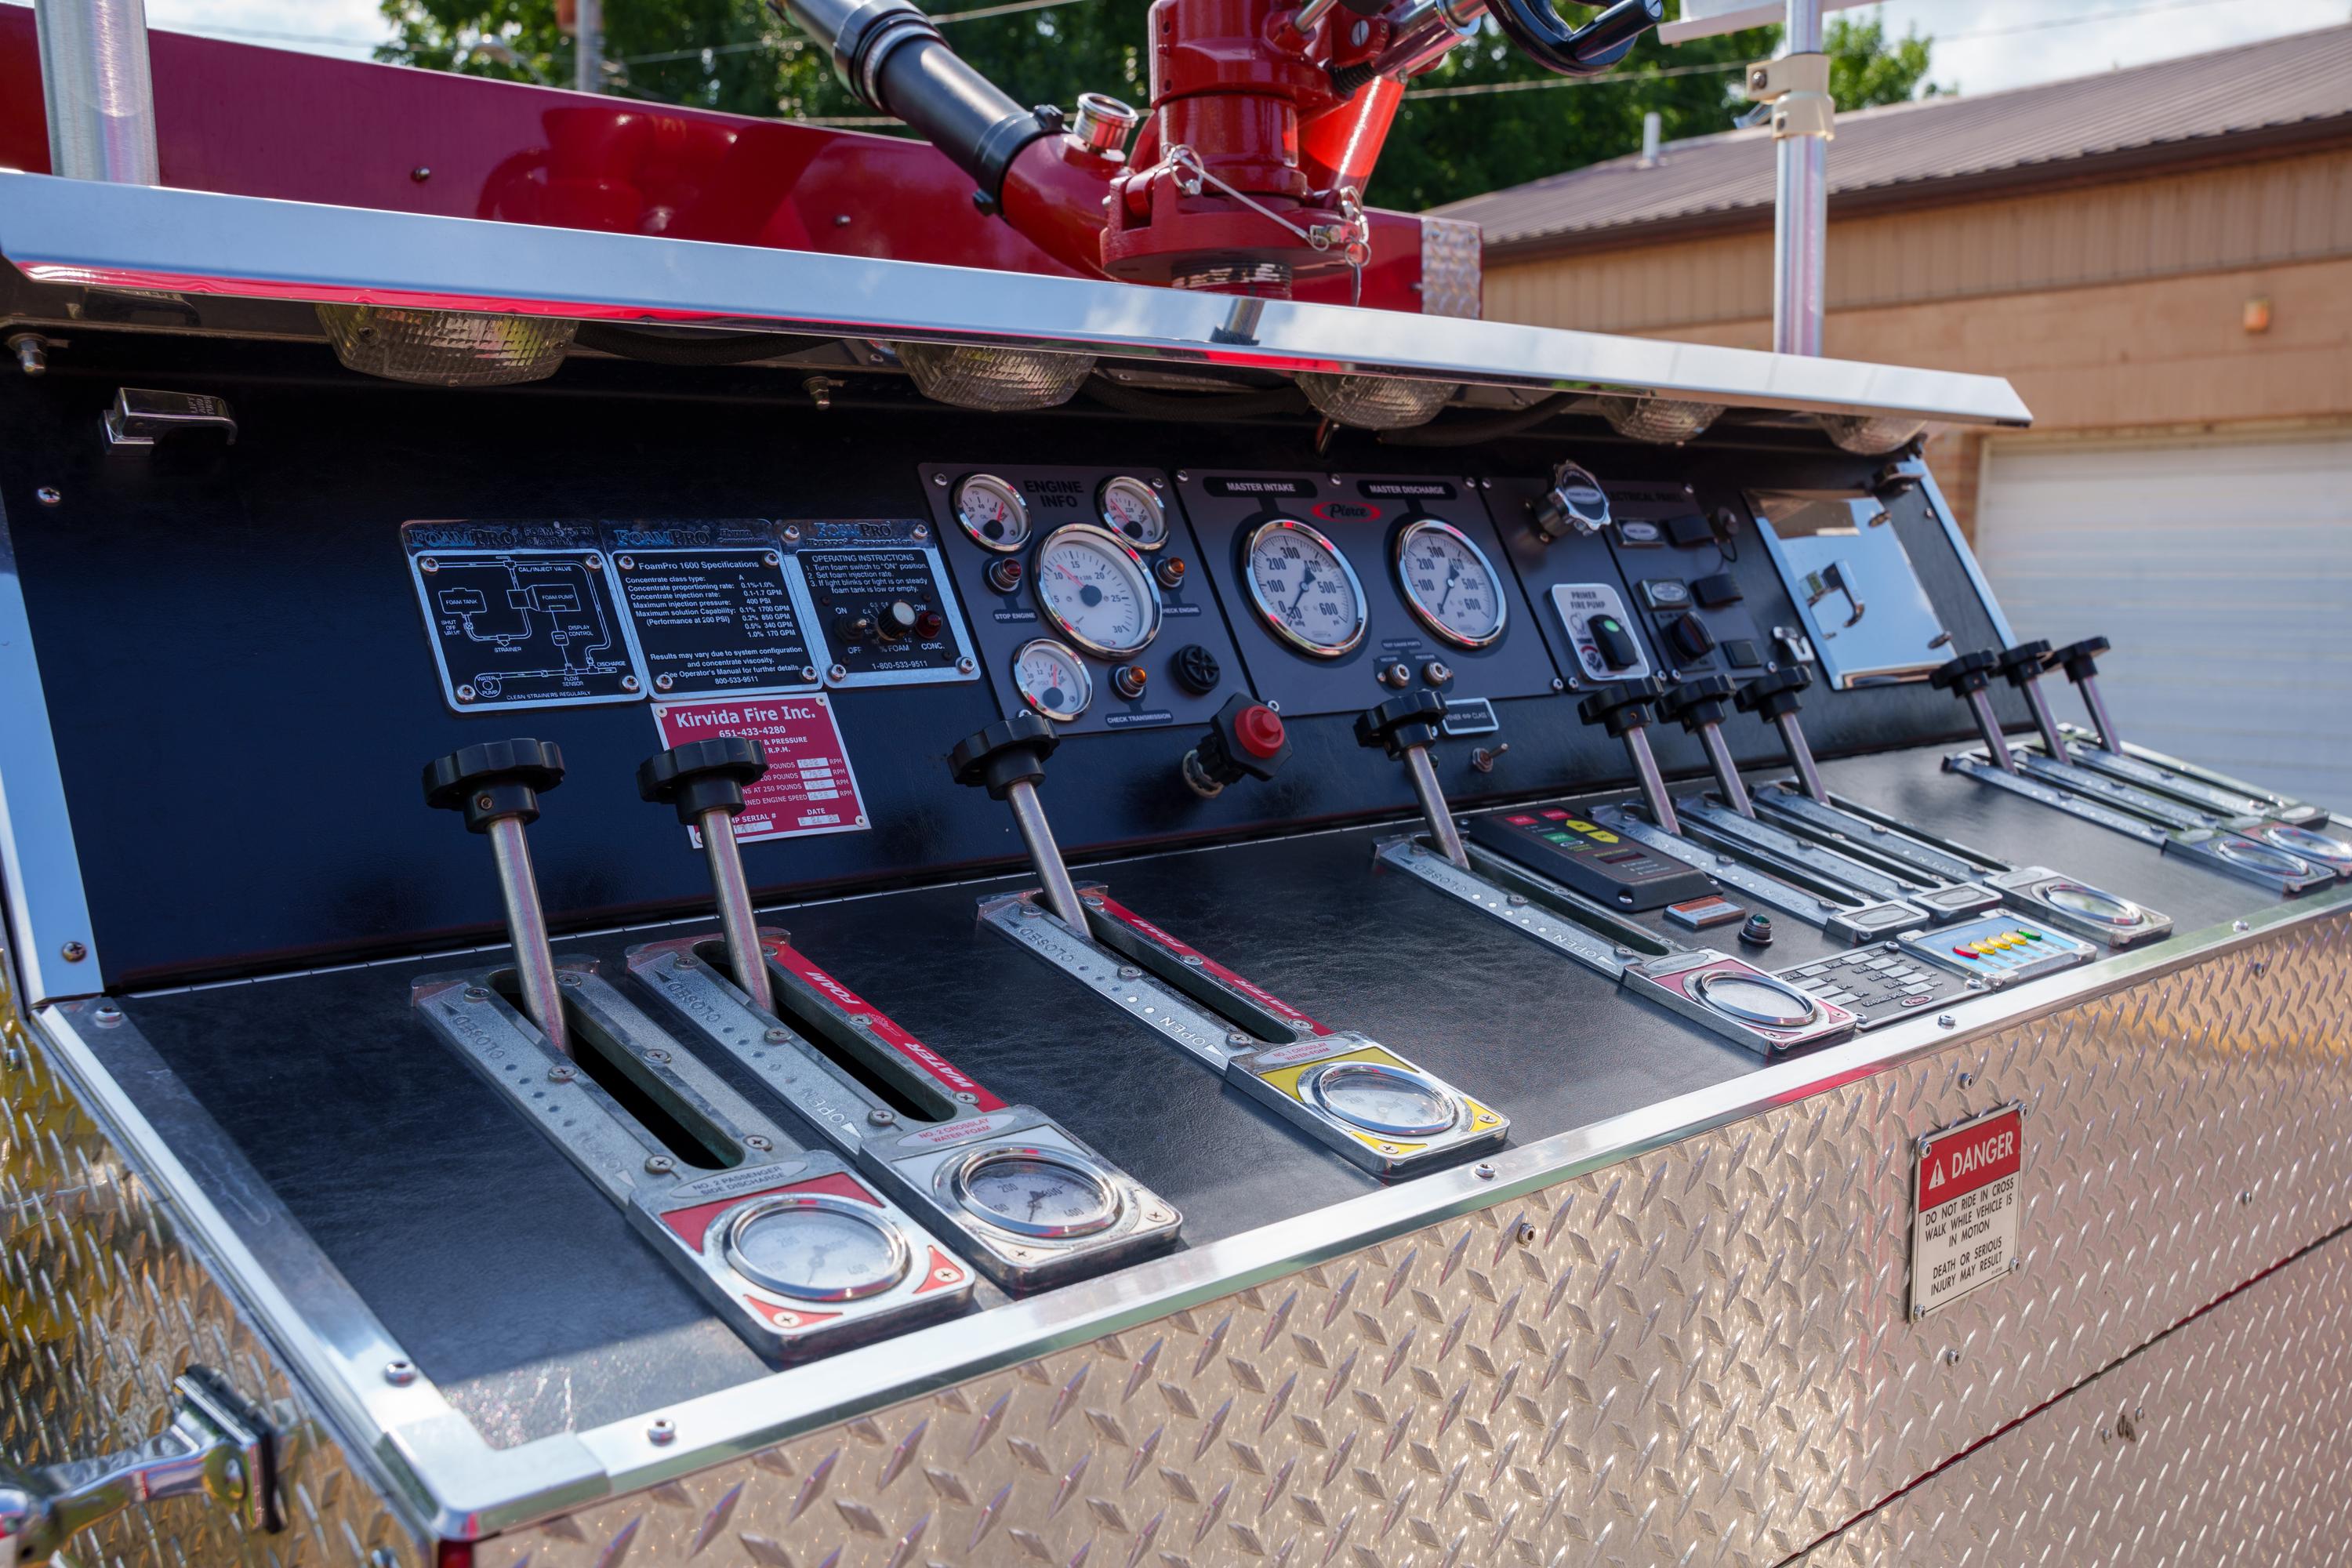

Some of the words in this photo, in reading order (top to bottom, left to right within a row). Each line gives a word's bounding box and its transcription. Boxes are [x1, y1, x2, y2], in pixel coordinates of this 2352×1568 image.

[1025, 480, 1083, 493] ENGINE
[1227, 482, 1261, 492] MASTER
[1264, 483, 1295, 492] INTAKE
[1370, 485, 1400, 494] MASTER
[1403, 485, 1446, 495] DISCHARGE
[1040, 495, 1078, 507] INFO
[1330, 504, 1368, 518] Pierce
[1280, 547, 1300, 558] 300
[1427, 546, 1445, 558] 300
[702, 561, 759, 571] Specifications
[1267, 558, 1286, 570] 200
[1417, 558, 1434, 570] 200
[672, 583, 718, 592] proportioning
[1268, 580, 1285, 592] 100
[1318, 582, 1336, 593] 500
[1418, 579, 1434, 590] 100
[1461, 578, 1479, 590] 500
[1278, 601, 1286, 612] 0
[1319, 603, 1338, 615] 600
[1465, 599, 1481, 610] 600
[872, 661, 927, 670] 1-800-533-9511
[675, 710, 739, 728] Kirvida
[744, 707, 778, 722] Fire
[784, 706, 815, 720] Inc.
[1128, 713, 1171, 722] TRANSMISSION
[719, 726, 786, 738] 651-433-4280
[1414, 863, 1467, 892] CLOSED
[1131, 919, 1185, 948] FOAM
[1020, 927, 1074, 962] CLOSED
[1554, 934, 1597, 958] OPEN
[806, 972, 860, 1004] FOAM
[1235, 979, 1302, 1017] WATER
[1160, 1016, 1206, 1047] OPEN
[1293, 1043, 1327, 1054] CROSSLAY
[905, 1043, 974, 1087] WATER
[797, 1087, 845, 1123] OPEN
[918, 1129, 935, 1138] NO.
[945, 1116, 989, 1134] CROSSLAY
[931, 1125, 991, 1144] WATER-FOAM
[1952, 1131, 2013, 1179] DANGER
[692, 1181, 712, 1192] NO.
[721, 1166, 782, 1184] PASSENGER
[998, 1183, 1018, 1192] 200
[1926, 1214, 1936, 1227] DO
[1942, 1202, 1957, 1221] NOT
[1962, 1194, 1976, 1210] RIDE
[1981, 1189, 1988, 1200] IN
[1992, 1178, 2013, 1196] CROSS
[1064, 1207, 1084, 1217] 400
[1926, 1225, 1946, 1242] WALK
[1951, 1211, 1971, 1231] WHILE
[1976, 1198, 2002, 1218] VEHICLE
[2006, 1193, 2012, 1204] IS
[1949, 1236, 1957, 1247] IN
[1962, 1219, 1989, 1242] MOTION
[1933, 1257, 1955, 1279] DEATH
[1960, 1252, 1969, 1263] OR
[1975, 1236, 2002, 1259] SERIOUS
[1931, 1274, 1955, 1296] INJURY
[1960, 1263, 1976, 1283] MAY
[1980, 1251, 2002, 1274] RESULT
